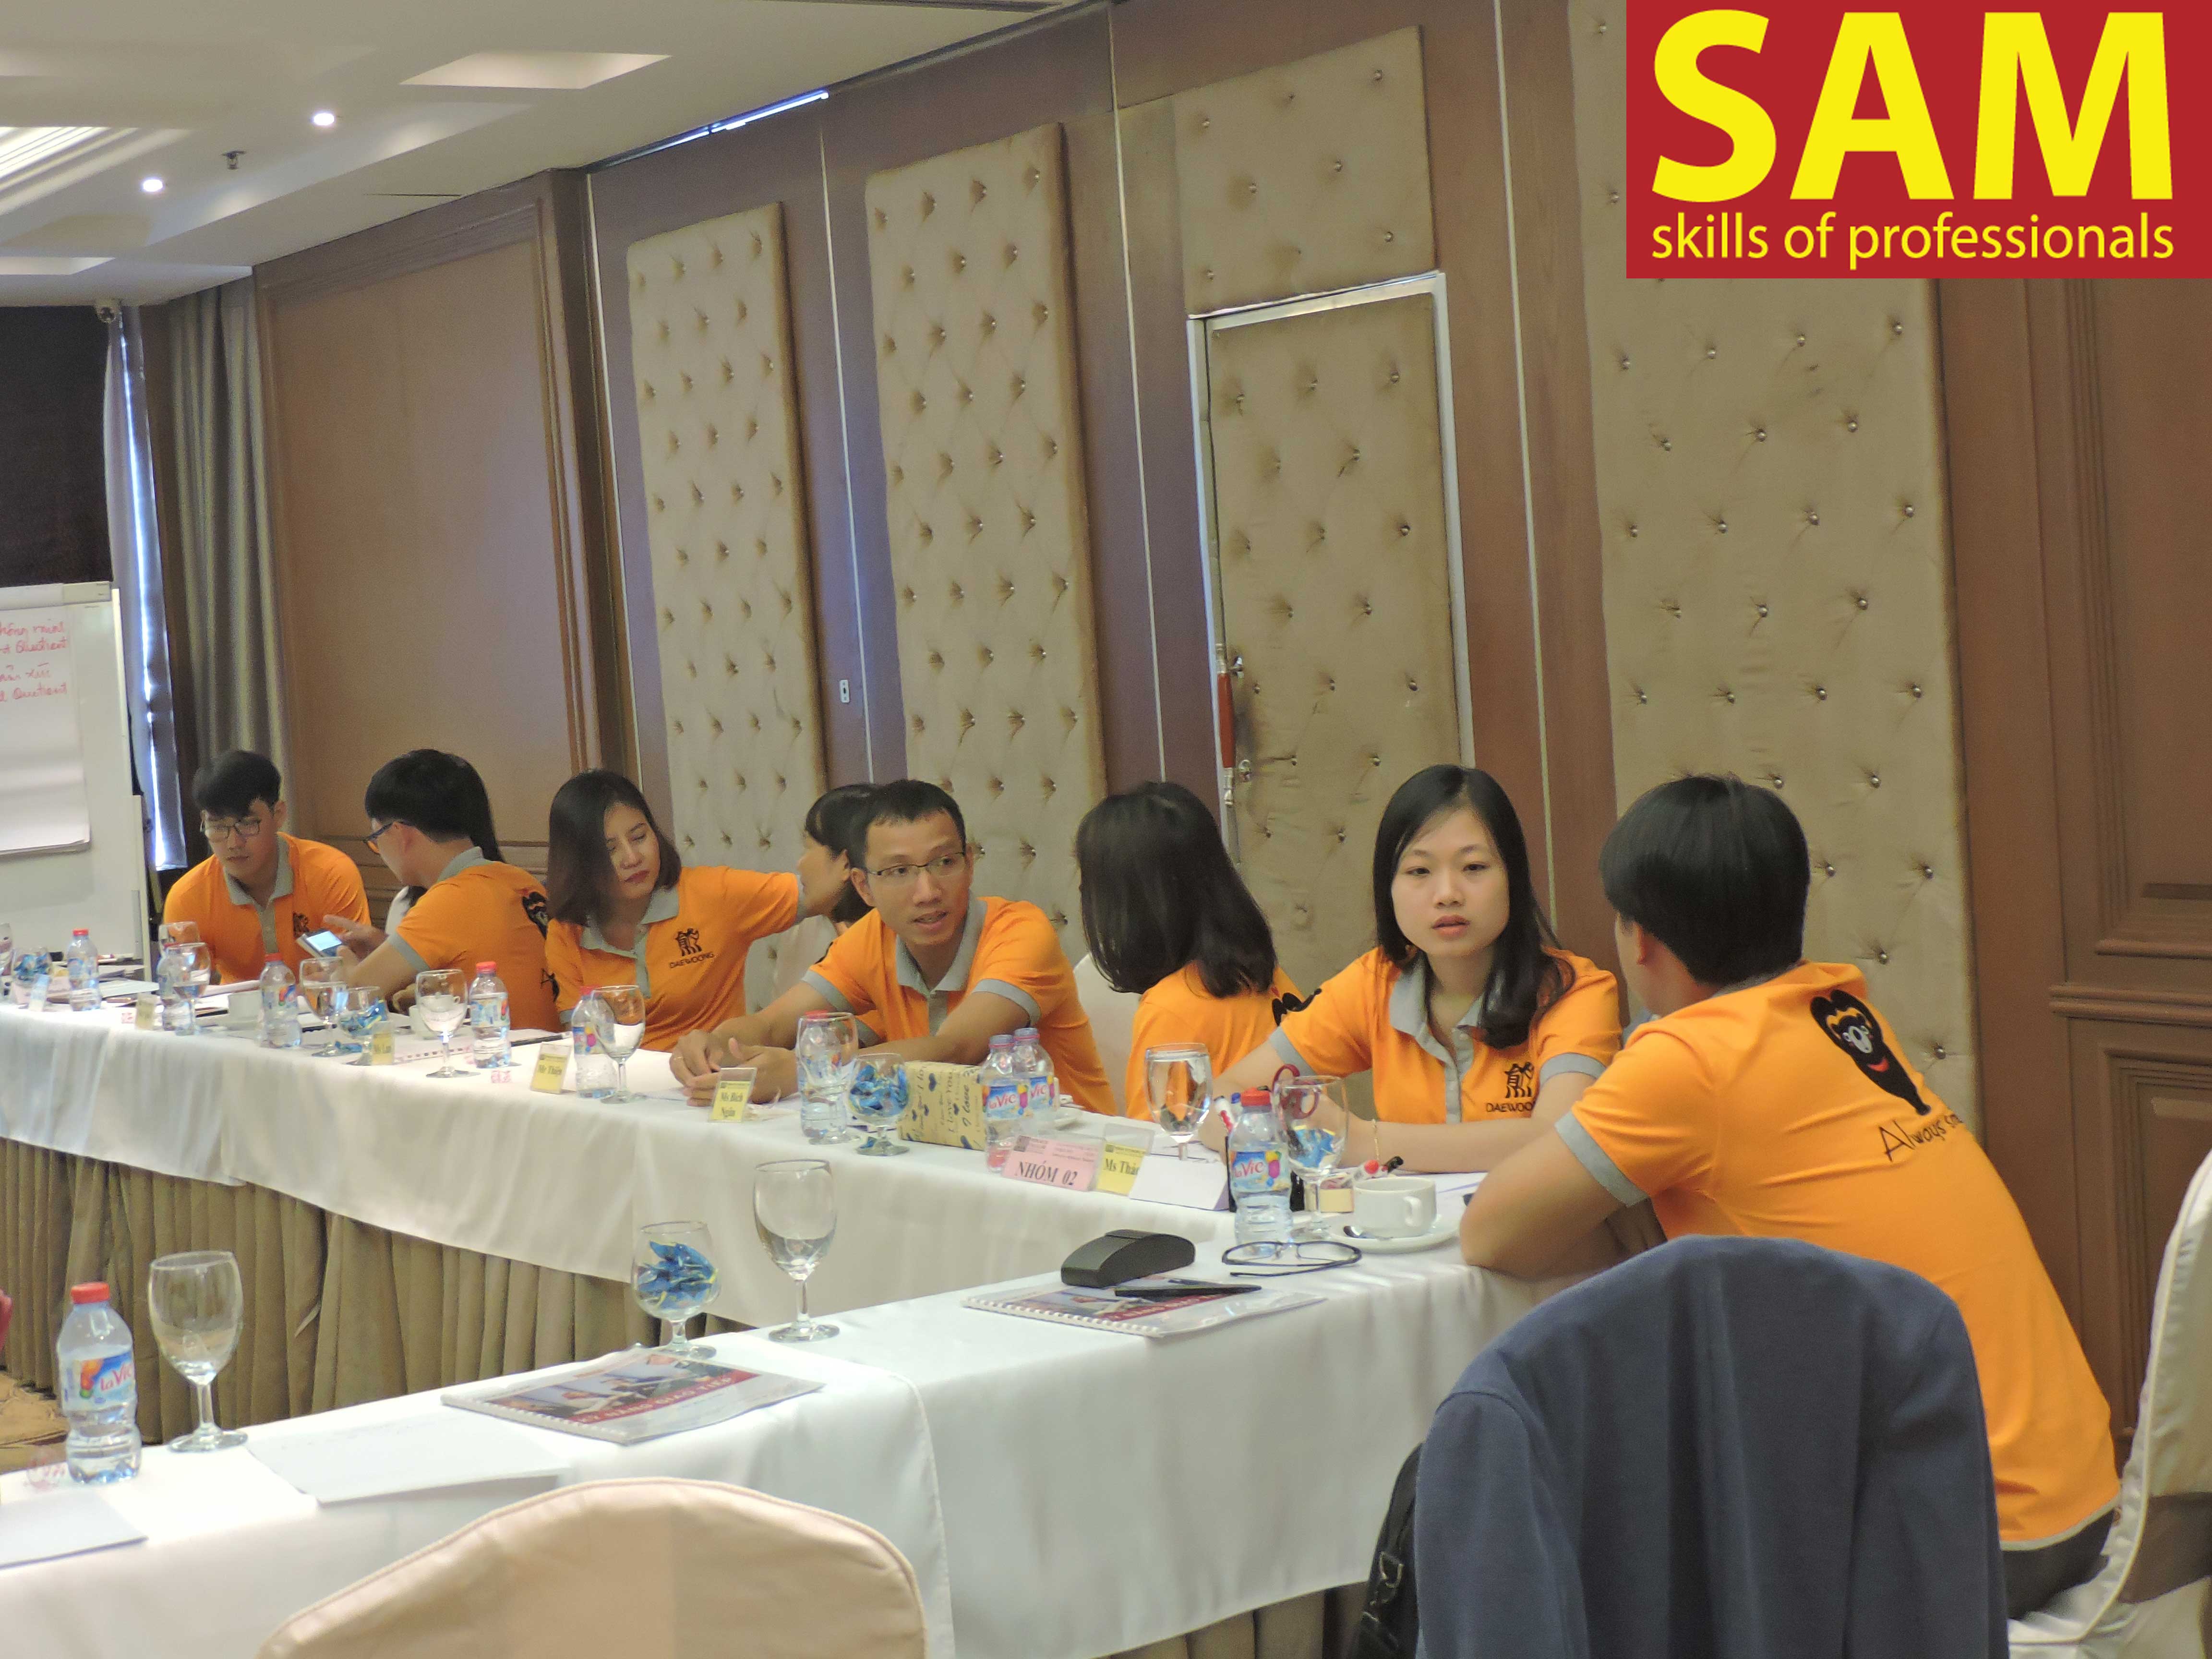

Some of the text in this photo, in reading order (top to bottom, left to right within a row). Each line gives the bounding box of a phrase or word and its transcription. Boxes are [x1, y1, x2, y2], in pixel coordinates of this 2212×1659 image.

[1878, 1118, 1947, 1162] Always
[1015, 1160, 1078, 1186] NHÓM 02
